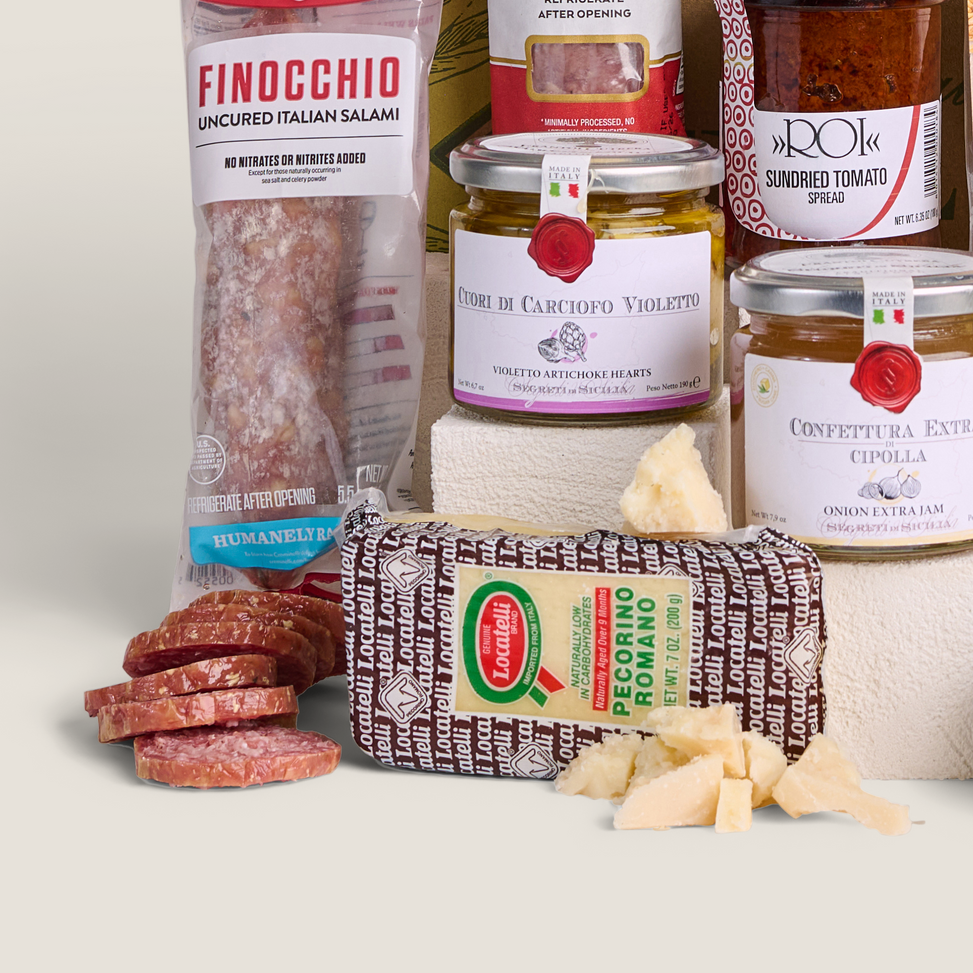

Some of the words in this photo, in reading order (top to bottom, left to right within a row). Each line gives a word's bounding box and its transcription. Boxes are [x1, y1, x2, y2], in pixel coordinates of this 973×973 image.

[538, 10, 574, 18] AFTER
[577, 9, 631, 18] OPENING
[199, 57, 400, 107] FINOCCHIO
[198, 111, 274, 131] UNCURED
[277, 109, 337, 125] ITALIAN
[340, 107, 400, 122] SALAMI
[225, 157, 236, 169] NO
[239, 155, 279, 168] NITRATES
[282, 155, 293, 165] OR
[296, 153, 334, 165] NITRITES
[337, 153, 366, 164] ADDED
[766, 170, 829, 188] SUNDRIED
[833, 168, 887, 187] TOMATO
[808, 192, 844, 204] SPREAD
[493, 366, 541, 377] VIOLETTO
[543, 369, 608, 378] ARTICHOKE
[611, 368, 651, 378] HEARTS
[850, 450, 927, 464] CIPOLLA
[824, 506, 869, 516] ONION
[873, 506, 916, 516] EXTRA
[918, 504, 944, 515] JAM
[214, 528, 314, 548] HUMANELY
[524, 602, 539, 623] ITALY
[599, 589, 608, 616] Months
[573, 605, 583, 626] LOW
[483, 624, 491, 654] GENUINE
[493, 602, 511, 681] Locatelli
[531, 624, 540, 645] FROM
[580, 596, 591, 684] CARBOHYDRATES
[599, 627, 607, 644] Over
[570, 628, 581, 688] NATURALLY
[597, 647, 607, 667] Aged
[612, 586, 634, 716] PECORINO
[634, 598, 656, 707] ROMANO
[523, 647, 540, 686] IMPORTED
[579, 687, 590, 700] IN
[595, 670, 607, 709] Naturally
